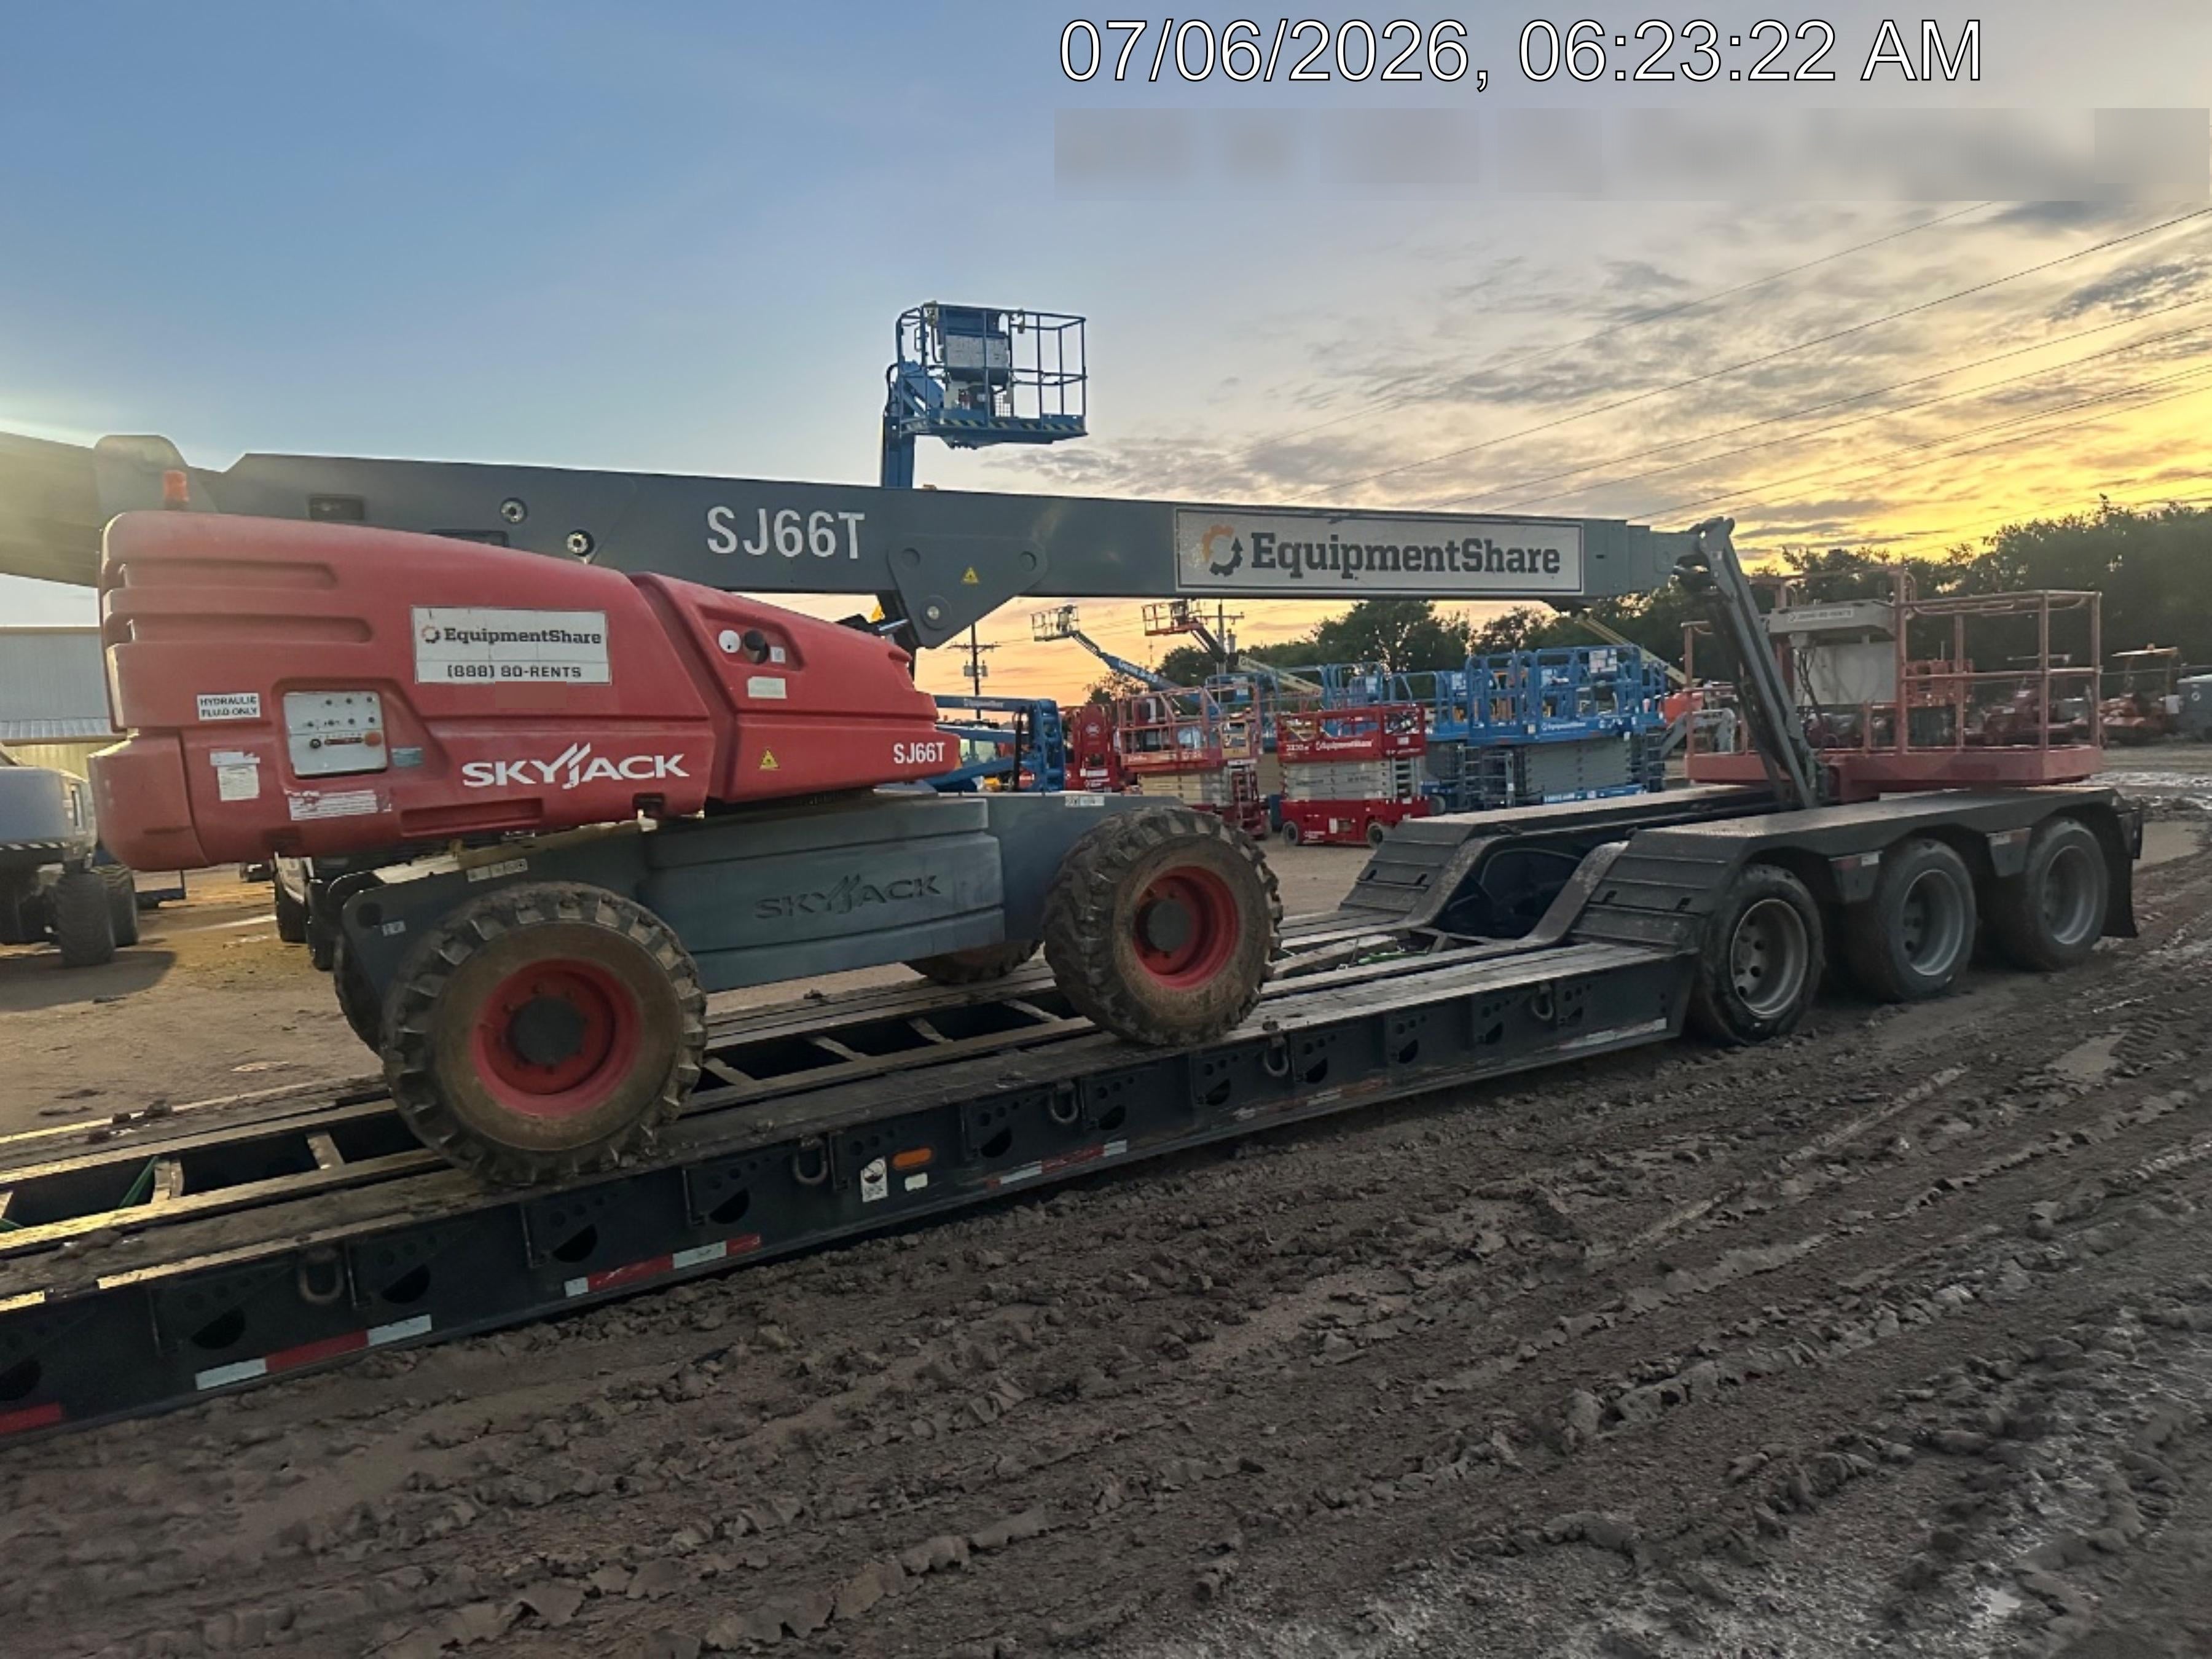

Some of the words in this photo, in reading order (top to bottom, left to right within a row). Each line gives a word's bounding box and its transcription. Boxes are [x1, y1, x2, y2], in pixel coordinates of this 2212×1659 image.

[707, 506, 866, 560] SJ66T
[1250, 531, 1561, 580] EquipmentShare
[444, 627, 602, 645] EquipmentShare
[447, 665, 495, 678] (888)
[501, 665, 582, 678] 80-RENTS
[232, 707, 257, 716] ONLY
[461, 742, 690, 790] SKYJACK
[893, 742, 946, 764] SJ66T
[754, 873, 941, 919] SKYJACK
